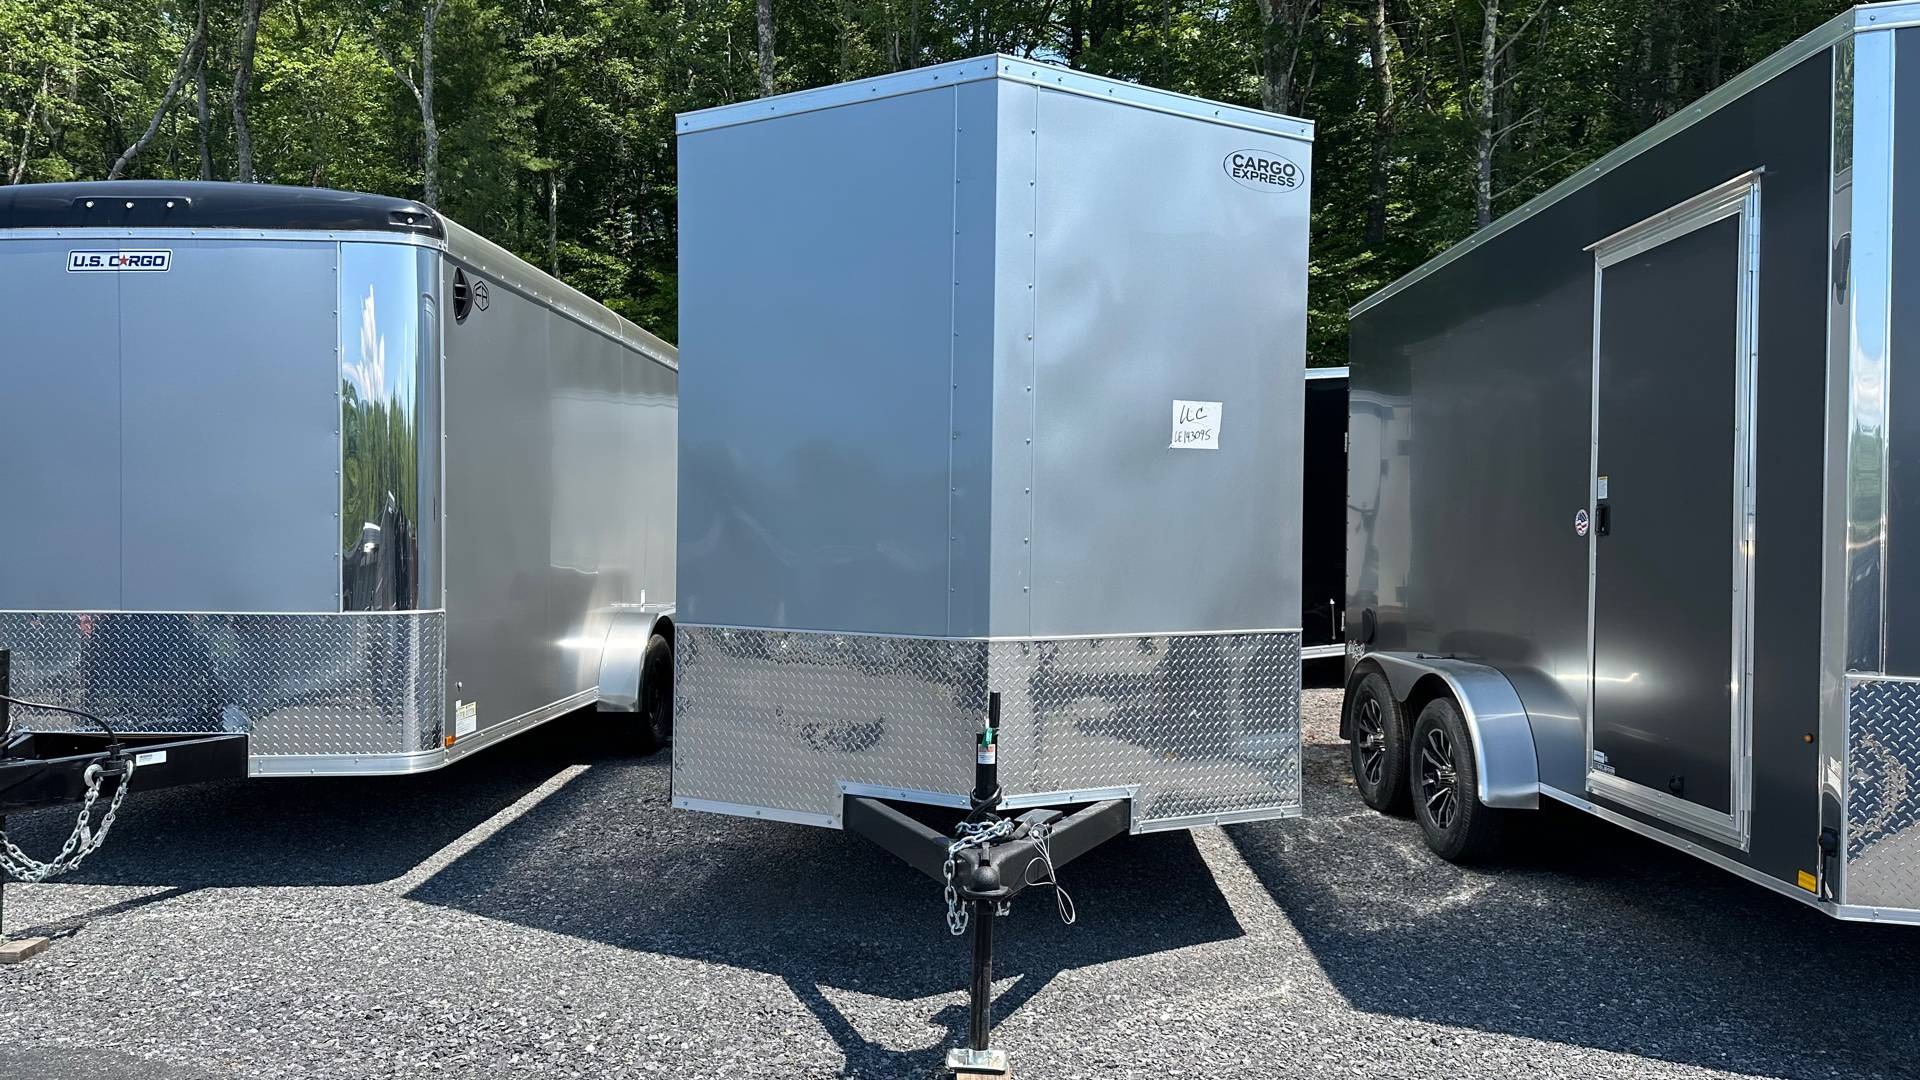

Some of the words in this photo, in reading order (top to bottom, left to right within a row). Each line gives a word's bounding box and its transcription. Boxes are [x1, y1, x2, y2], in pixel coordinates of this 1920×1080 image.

[1232, 153, 1296, 177] CARGO
[1232, 167, 1295, 187] EXPRESS
[73, 255, 104, 267] U.S.
